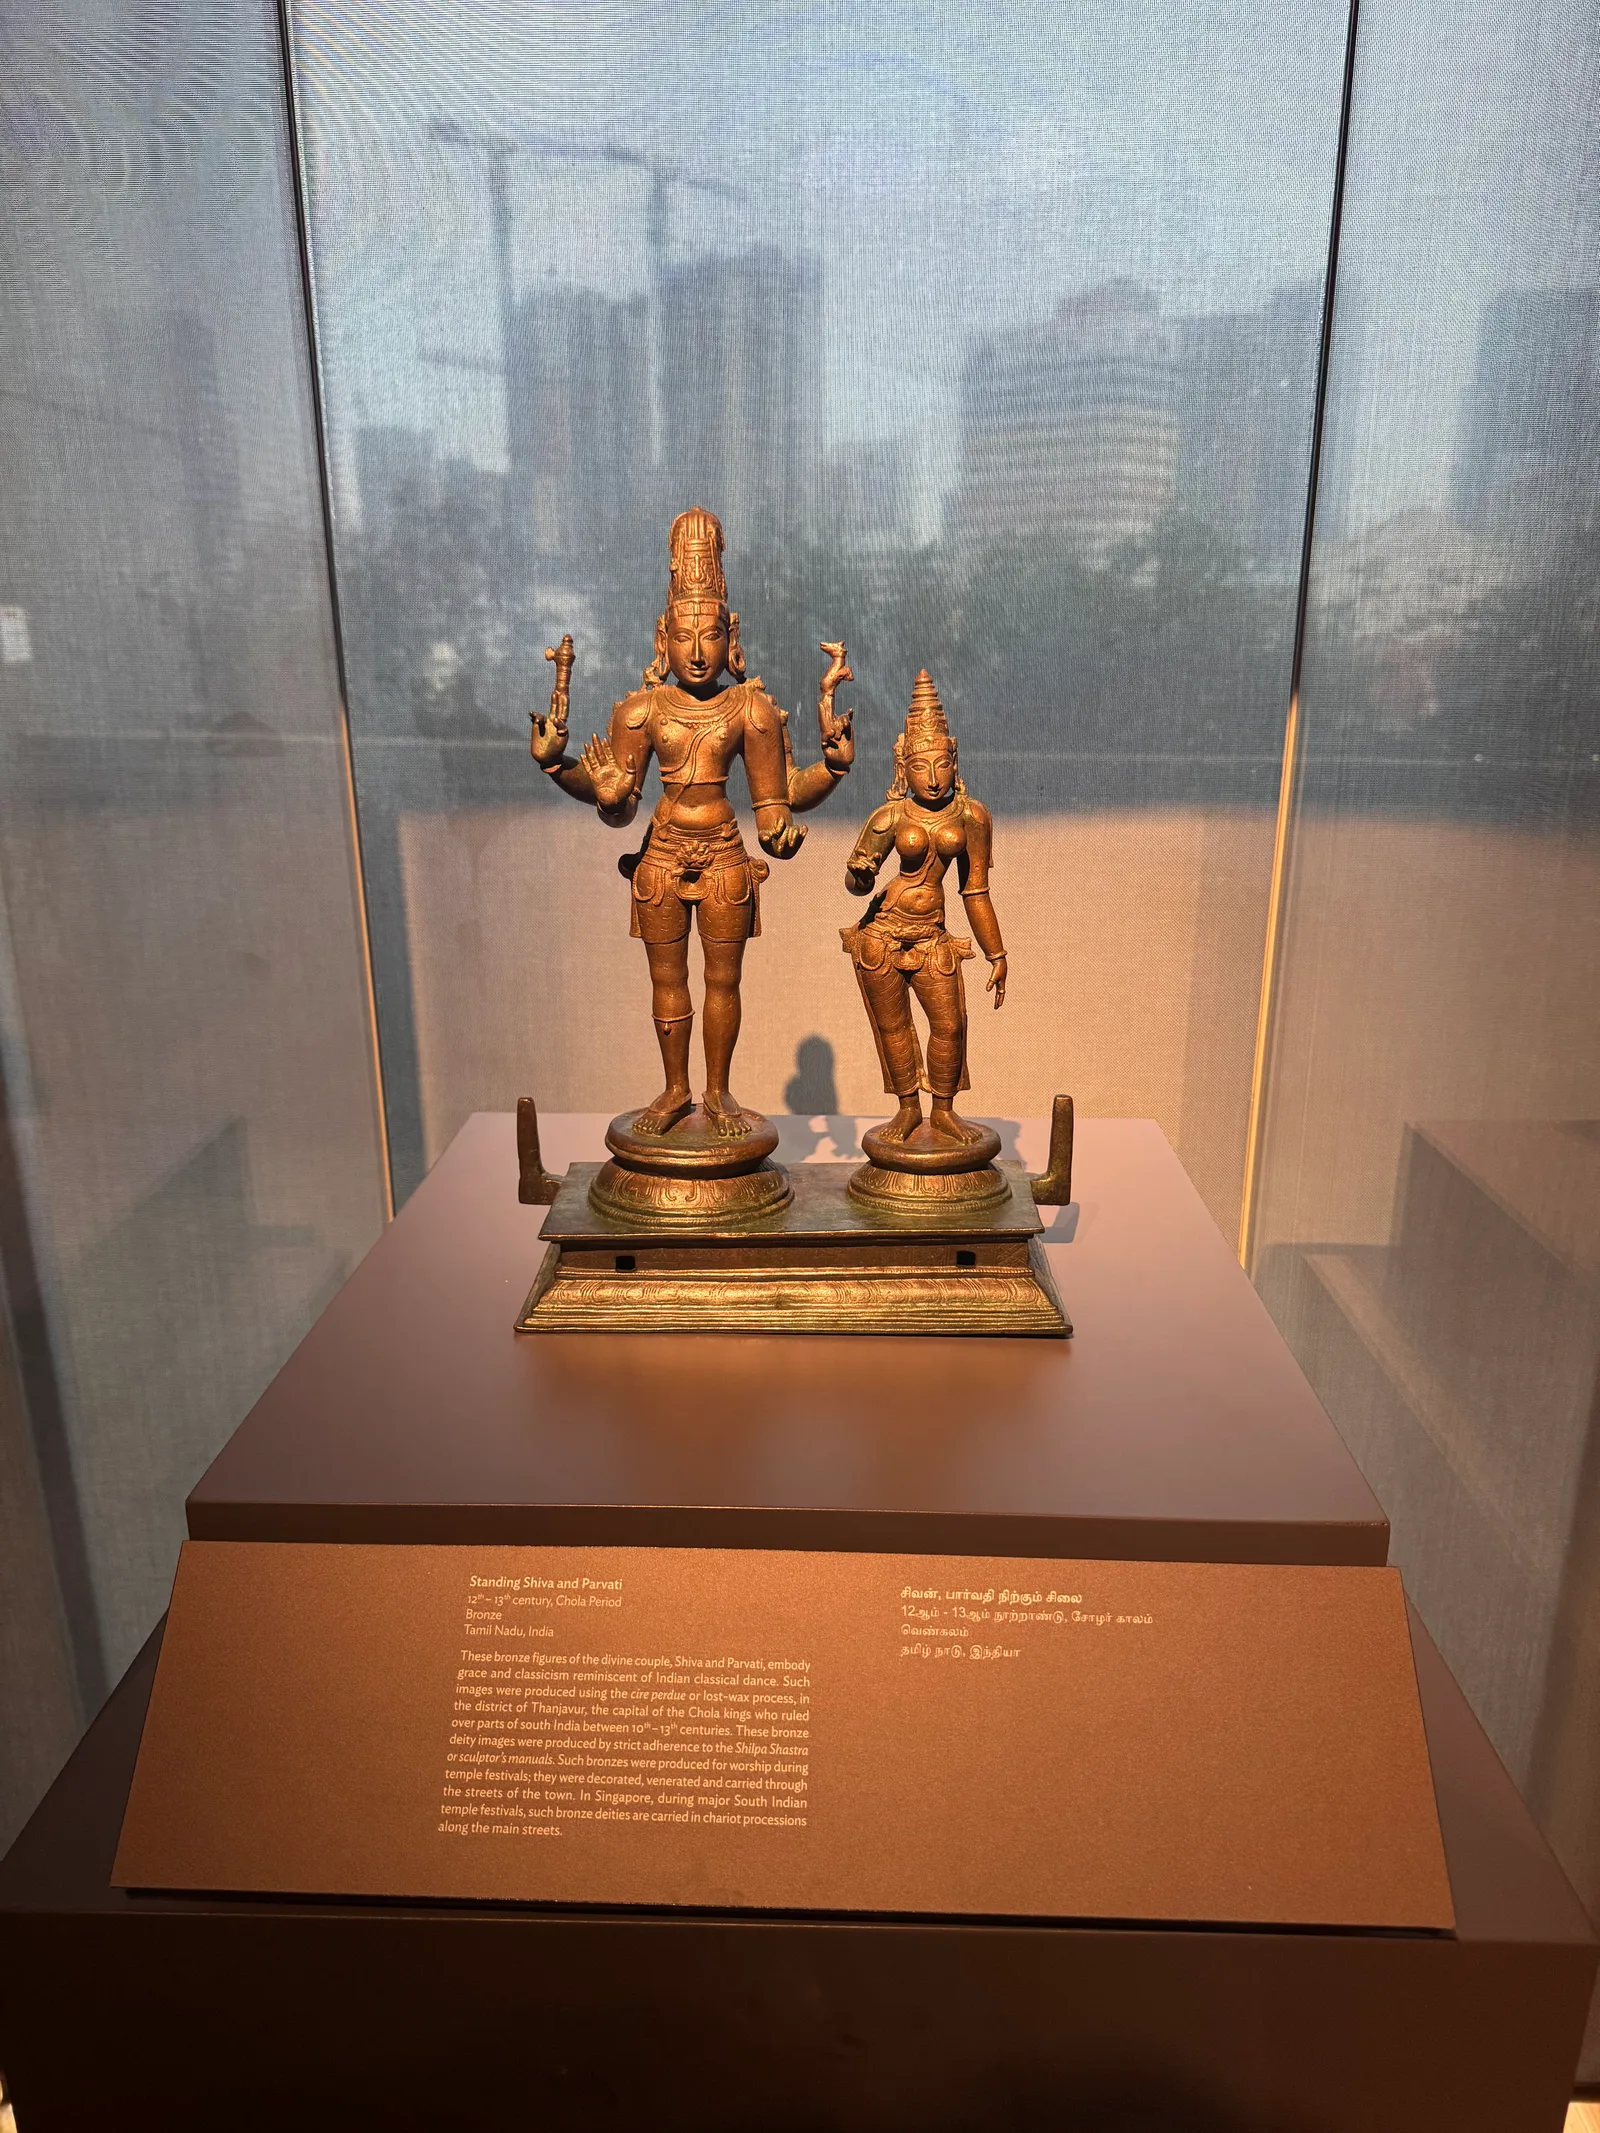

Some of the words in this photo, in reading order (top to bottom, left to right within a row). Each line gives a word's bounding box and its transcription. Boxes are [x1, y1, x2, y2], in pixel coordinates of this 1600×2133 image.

[469, 1575, 521, 1591] Standing
[523, 1576, 554, 1589] Shiva
[556, 1577, 579, 1589] and
[582, 1577, 623, 1590] Parvati
[512, 1596, 553, 1608] century,
[556, 1594, 587, 1607] Chola
[588, 1595, 622, 1608] Period
[900, 1586, 941, 1600] சிவன்,
[945, 1588, 994, 1604] பார்வதி
[998, 1589, 1042, 1605] நிற்கும்
[1046, 1590, 1082, 1603] சிலை
[465, 1608, 503, 1620] Bronze
[901, 1605, 940, 1620] 12ஆம்
[952, 1606, 990, 1622] 13ஆம்
[994, 1609, 1068, 1623] நூற்றாண்டு,
[1071, 1610, 1113, 1625] சோழர்
[1116, 1613, 1153, 1623] காலம்
[464, 1623, 492, 1635] Tamil
[494, 1625, 526, 1638] Nadu,
[528, 1625, 554, 1637] India
[900, 1624, 969, 1636] வெண்கலம்
[460, 1649, 493, 1662] These
[494, 1651, 531, 1663] bronze
[532, 1651, 567, 1666] figures
[569, 1653, 581, 1664] of
[582, 1653, 600, 1665] the
[601, 1653, 633, 1666] divine
[634, 1655, 673, 1669] couple,
[675, 1655, 703, 1668] Shiva
[705, 1657, 725, 1668] and
[727, 1657, 766, 1671] Parvati,
[767, 1658, 811, 1673] embody
[900, 1643, 931, 1658] தமிழ்
[934, 1645, 966, 1658] நாடு,
[969, 1645, 1021, 1660] இந்தியா
[457, 1669, 487, 1680] grace
[490, 1668, 512, 1679] and
[515, 1668, 569, 1680] classicism
[573, 1671, 637, 1682] reminiscent
[641, 1671, 653, 1682] of
[656, 1672, 690, 1683] Indian
[694, 1673, 739, 1685] classical
[743, 1674, 779, 1686] dance.
[783, 1675, 810, 1687] Such
[455, 1683, 493, 1697] images
[496, 1687, 522, 1696] were
[524, 1685, 576, 1698] produced
[579, 1687, 608, 1702] using
[610, 1687, 628, 1699] the
[630, 1688, 650, 1699] cire
[650, 1689, 686, 1702] perdue
[688, 1693, 701, 1701] or
[703, 1690, 749, 1702] lost-wax
[752, 1695, 797, 1706] process,
[799, 1693, 810, 1704] in
[453, 1699, 472, 1711] the
[474, 1700, 513, 1713] district
[516, 1701, 529, 1713] of
[531, 1701, 588, 1717] Thanjavur,
[591, 1704, 609, 1716] the
[612, 1705, 649, 1719] capital
[651, 1705, 664, 1717] of
[666, 1706, 685, 1718] the
[688, 1706, 721, 1719] Chola
[723, 1707, 752, 1723] kings
[754, 1708, 778, 1721] who
[781, 1709, 810, 1722] ruled
[451, 1719, 476, 1728] over
[476, 1719, 505, 1731] parts
[507, 1718, 519, 1729] of
[520, 1719, 551, 1730] south
[553, 1719, 581, 1731] India
[583, 1720, 629, 1733] between
[679, 1724, 733, 1736] centuries.
[735, 1724, 769, 1737] These
[771, 1726, 809, 1738] bronze
[449, 1733, 476, 1748] deity
[478, 1734, 515, 1749] images
[517, 1739, 543, 1747] were
[544, 1737, 596, 1750] produced
[598, 1738, 611, 1752] by
[613, 1739, 641, 1751] strict
[643, 1740, 700, 1752] adherence
[702, 1743, 713, 1753] to
[715, 1742, 733, 1753] the
[735, 1742, 767, 1757] Shilpa
[769, 1743, 809, 1756] Shastra
[447, 1753, 458, 1761] or
[508, 1753, 555, 1765] manuals.
[557, 1754, 584, 1766] Such
[586, 1755, 628, 1767] bronzes
[630, 1759, 656, 1768] were
[658, 1758, 710, 1771] produced
[712, 1758, 727, 1770] for
[729, 1760, 772, 1774] worship
[774, 1760, 809, 1776] during
[445, 1768, 483, 1783] temple
[484, 1768, 531, 1784] festivals;
[533, 1770, 557, 1785] they
[559, 1774, 585, 1784] were
[586, 1772, 645, 1787] decorated,
[646, 1776, 701, 1788] venerated
[702, 1776, 723, 1788] and
[725, 1777, 763, 1790] carried
[765, 1778, 808, 1794] through
[443, 1784, 462, 1797] the
[464, 1788, 503, 1799] streets
[506, 1787, 519, 1799] of
[522, 1787, 541, 1800] the
[544, 1790, 576, 1801] town.
[580, 1789, 591, 1801] In
[594, 1789, 654, 1806] Singapore,
[657, 1791, 694, 1808] during
[697, 1794, 731, 1809] major
[734, 1794, 768, 1807] South
[772, 1795, 808, 1808] Indian
[440, 1802, 479, 1817] temple
[480, 1803, 527, 1819] festivals,
[528, 1805, 554, 1818] such
[555, 1806, 594, 1819] bronze
[594, 1807, 631, 1821] deities
[632, 1812, 650, 1821] are
[650, 1810, 689, 1823] carried
[690, 1811, 701, 1823] in
[702, 1811, 742, 1824] chariot
[742, 1814, 807, 1828] processions
[437, 1820, 469, 1836] along
[471, 1821, 490, 1833] the
[492, 1823, 520, 1834] main
[522, 1825, 563, 1836] streets.
